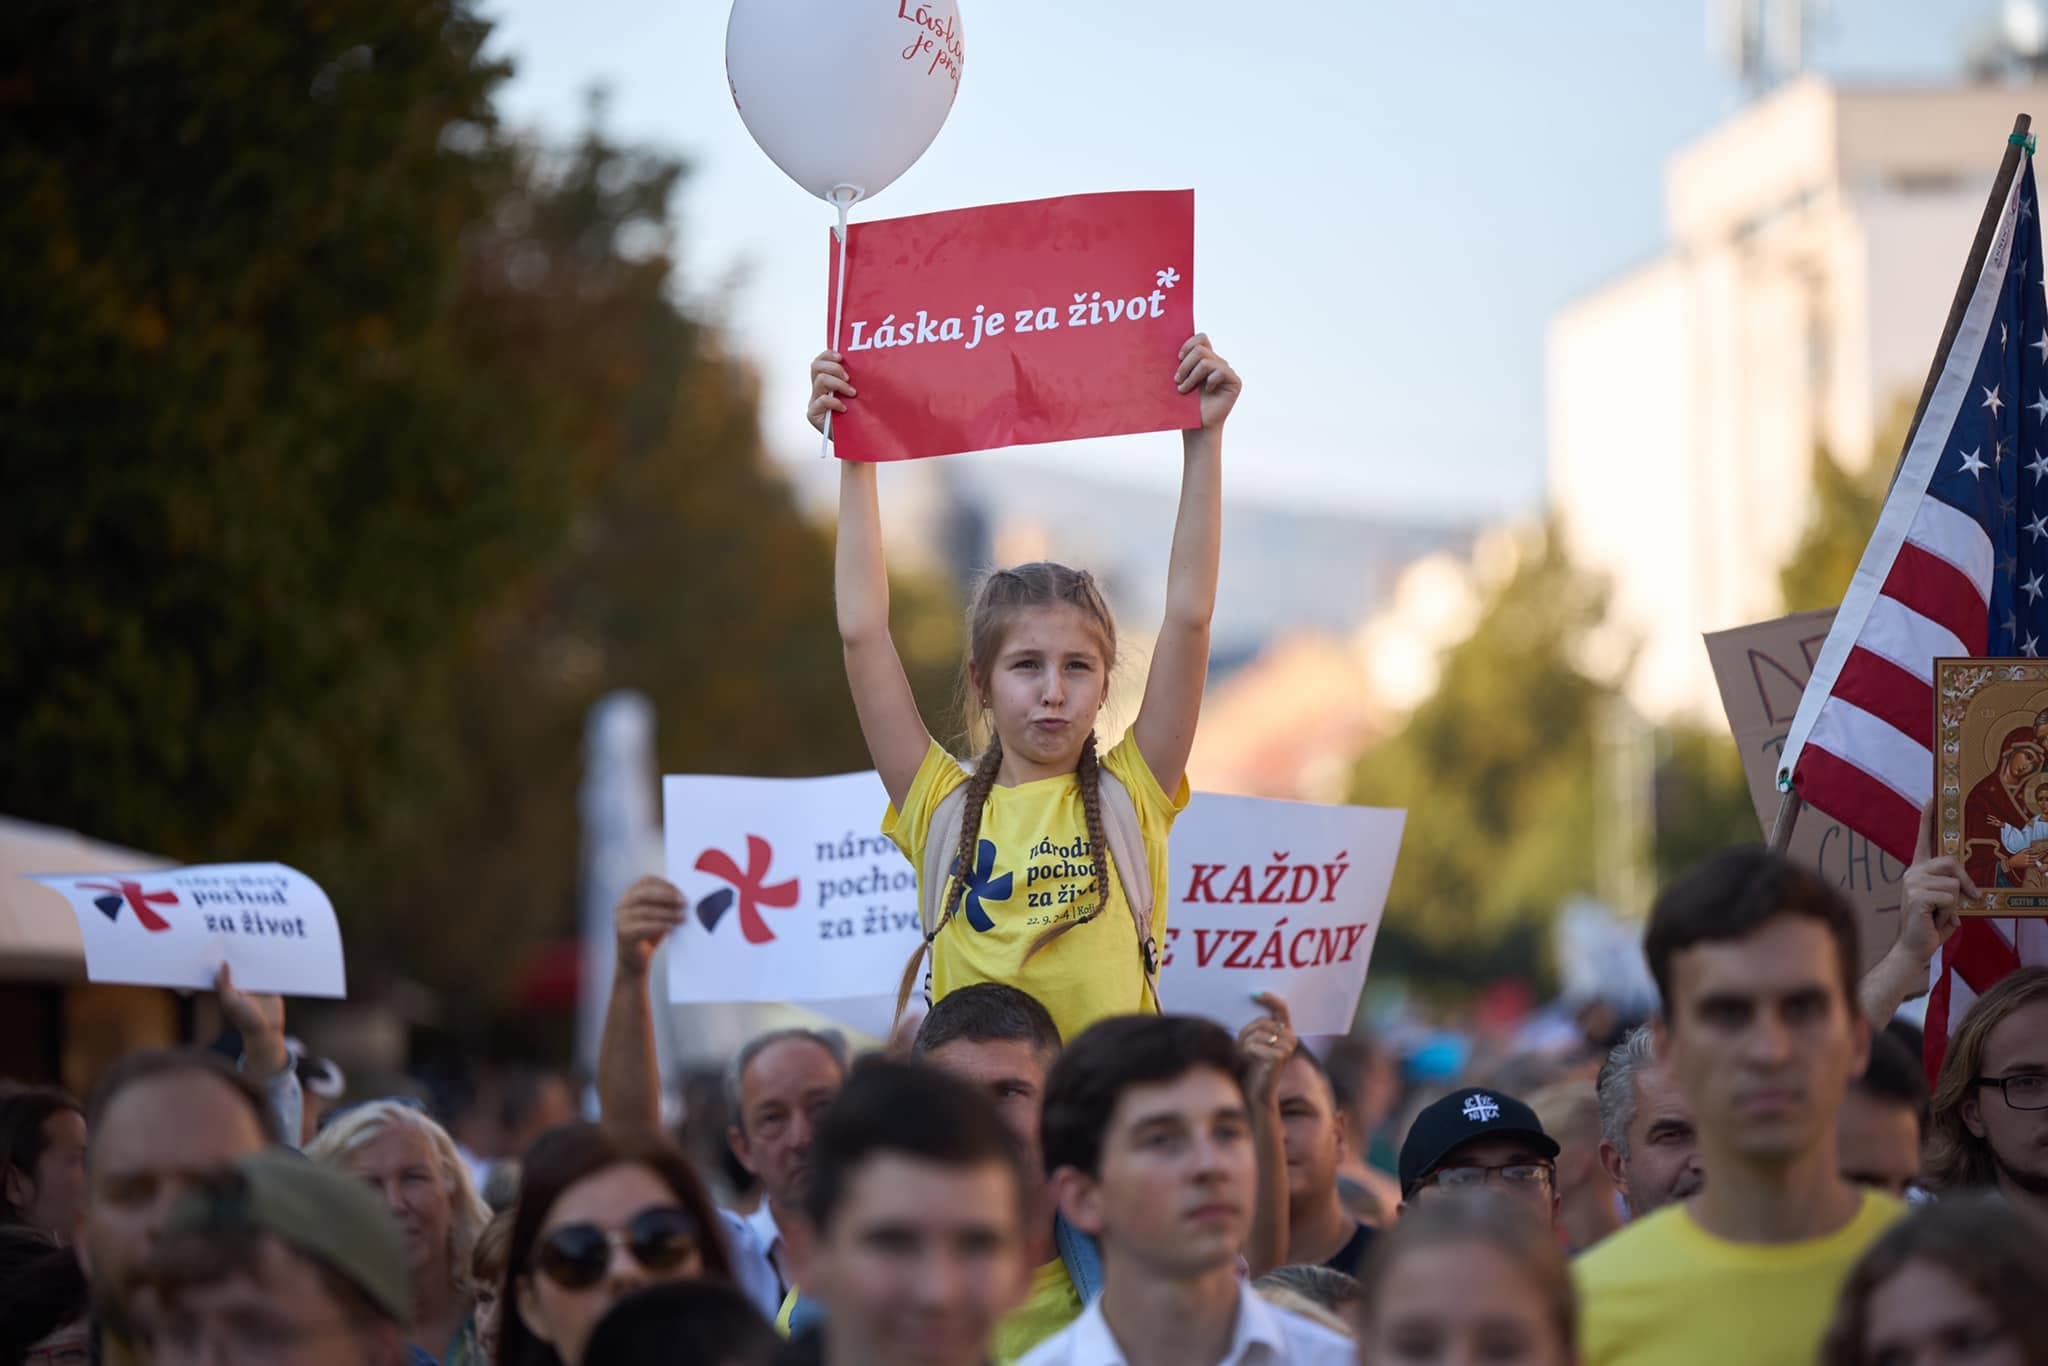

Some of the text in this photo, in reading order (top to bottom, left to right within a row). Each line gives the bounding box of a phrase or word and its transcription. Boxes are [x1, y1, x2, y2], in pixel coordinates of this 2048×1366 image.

[903, 31, 934, 60] je
[848, 289, 1166, 352] Láska je za život
[816, 830, 898, 862] náro
[1029, 836, 1093, 860] národn
[817, 865, 917, 908] pocho
[1182, 850, 1350, 904] KAŽDÝ
[1028, 892, 1053, 908] za
[204, 913, 237, 934] za
[818, 906, 921, 940] za živo
[1161, 917, 1369, 969] E VZÁCNY
